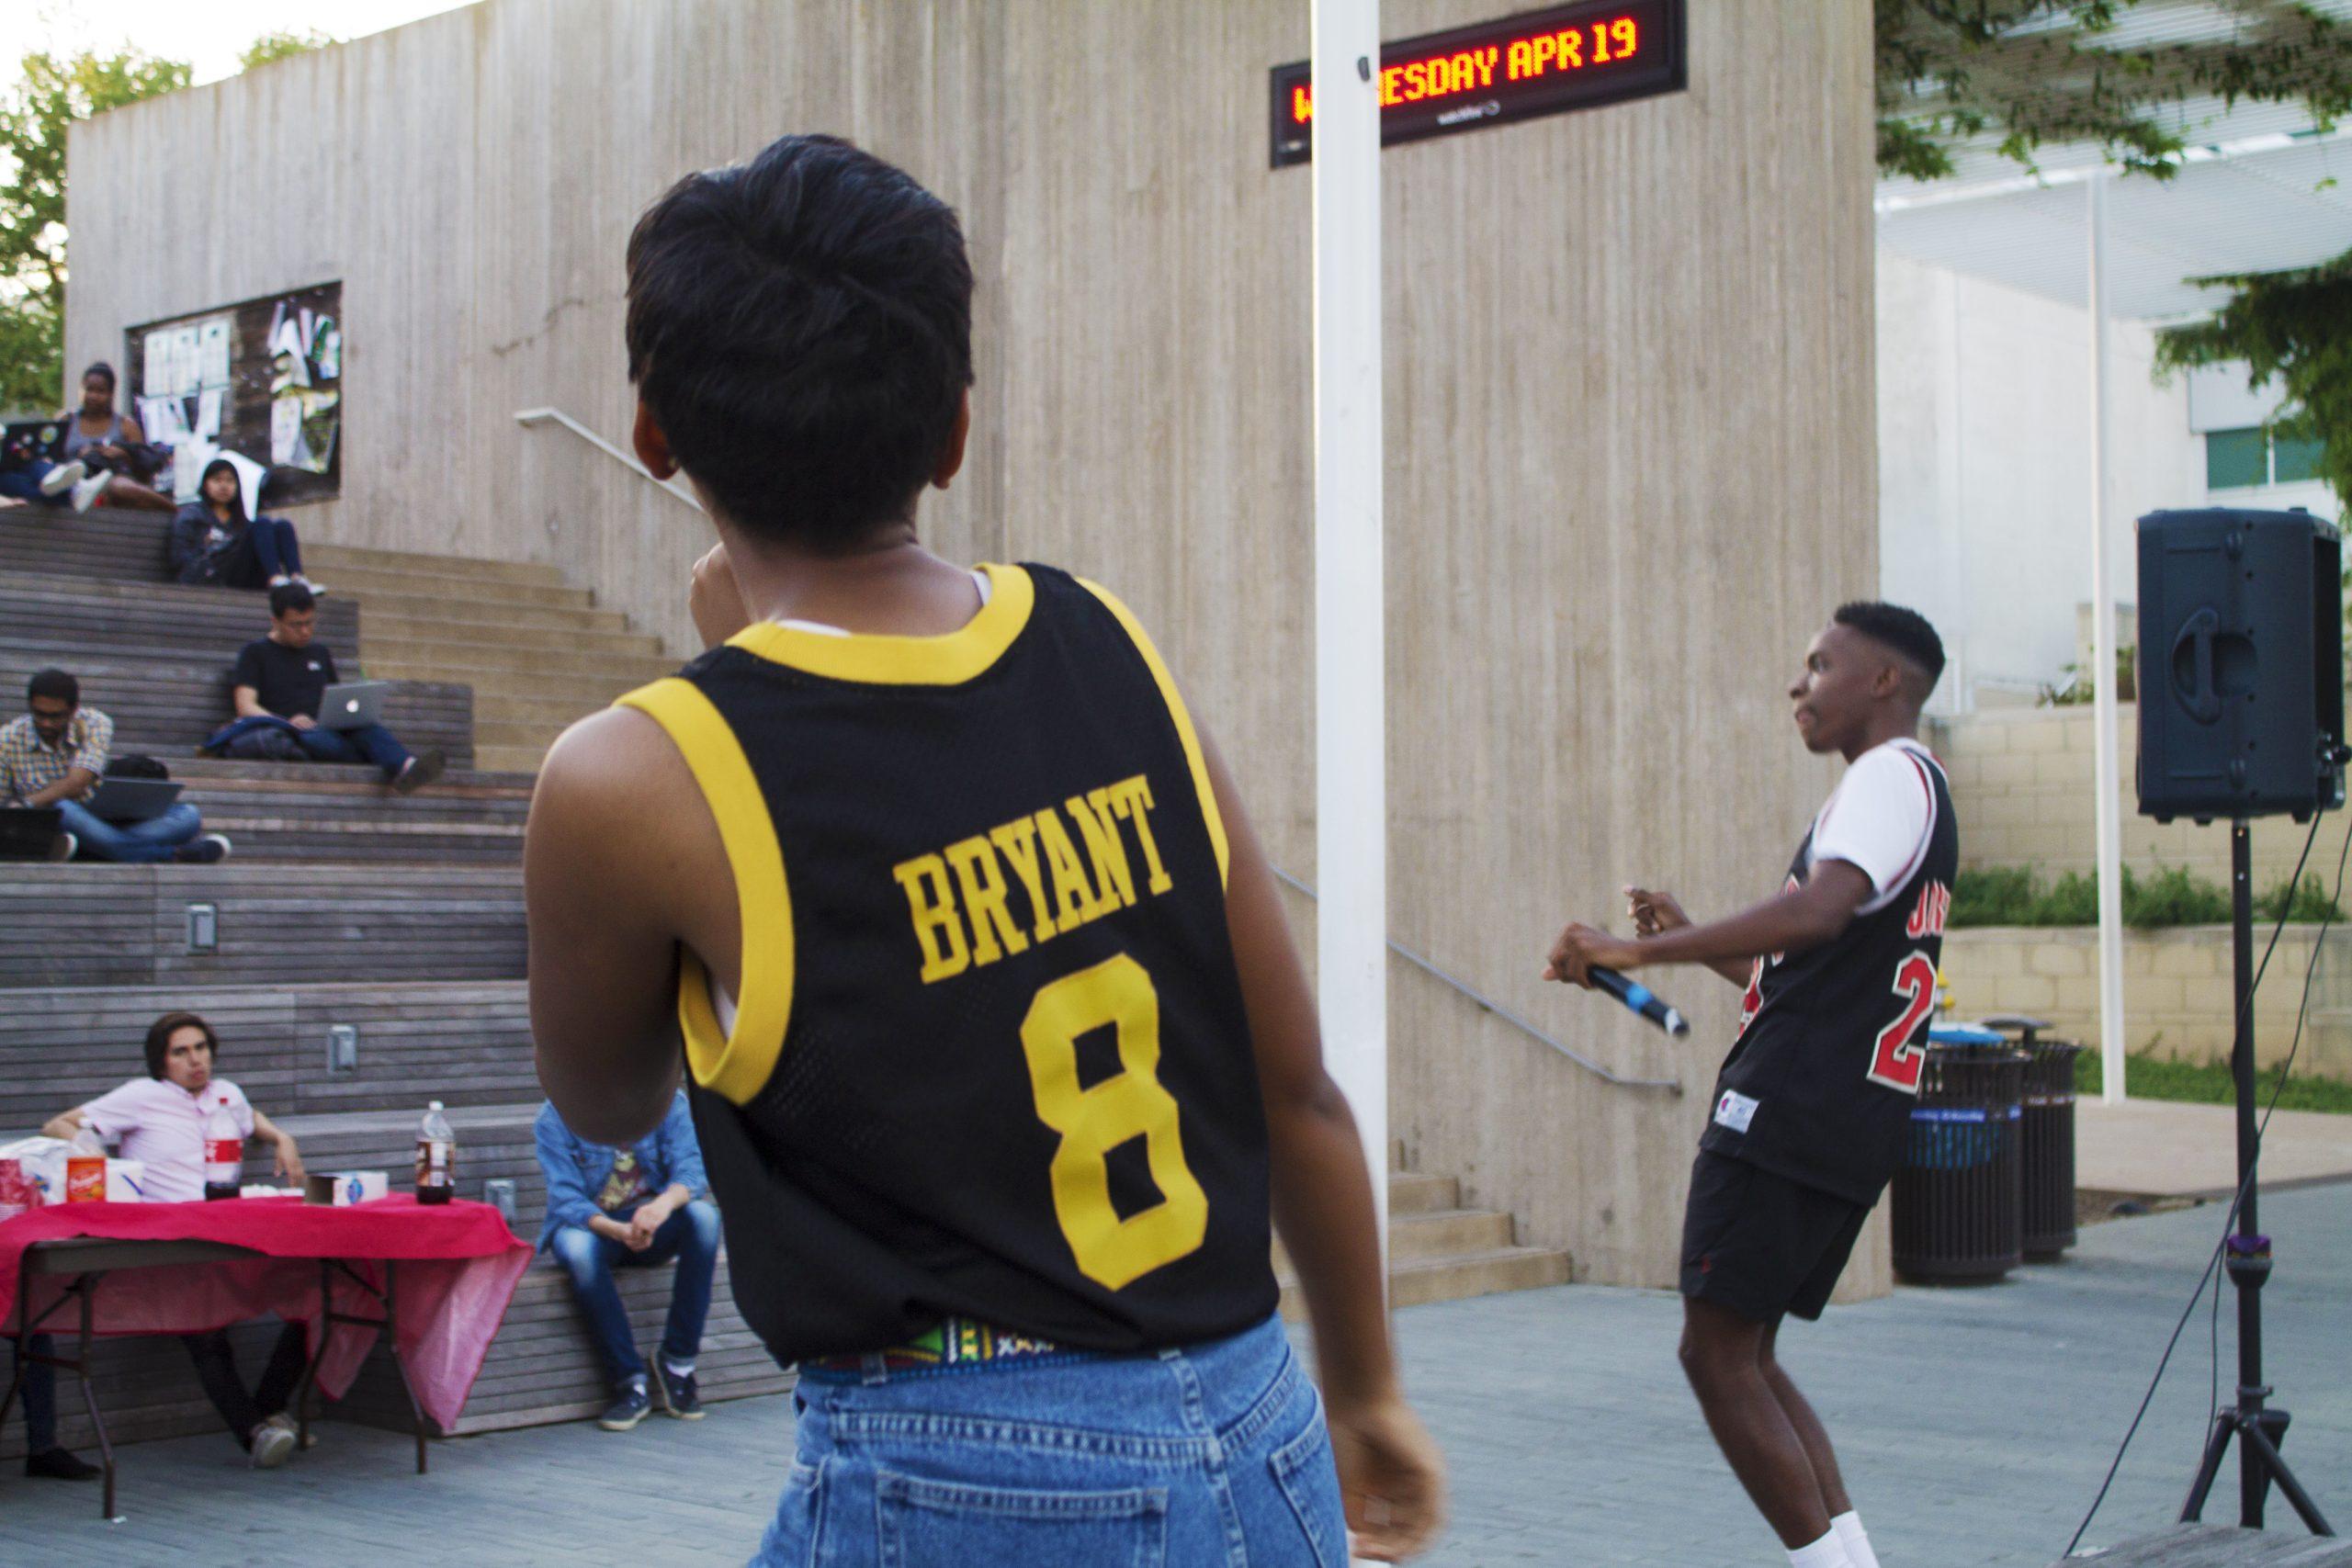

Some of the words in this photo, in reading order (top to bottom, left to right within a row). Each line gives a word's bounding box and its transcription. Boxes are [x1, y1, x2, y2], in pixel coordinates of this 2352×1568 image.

[1508, 29, 1582, 82] APR
[1590, 17, 1638, 63] 19
[892, 773, 1173, 985] BRYANT
[1866, 949, 1939, 1095] 2
[1020, 951, 1209, 1292] 8
